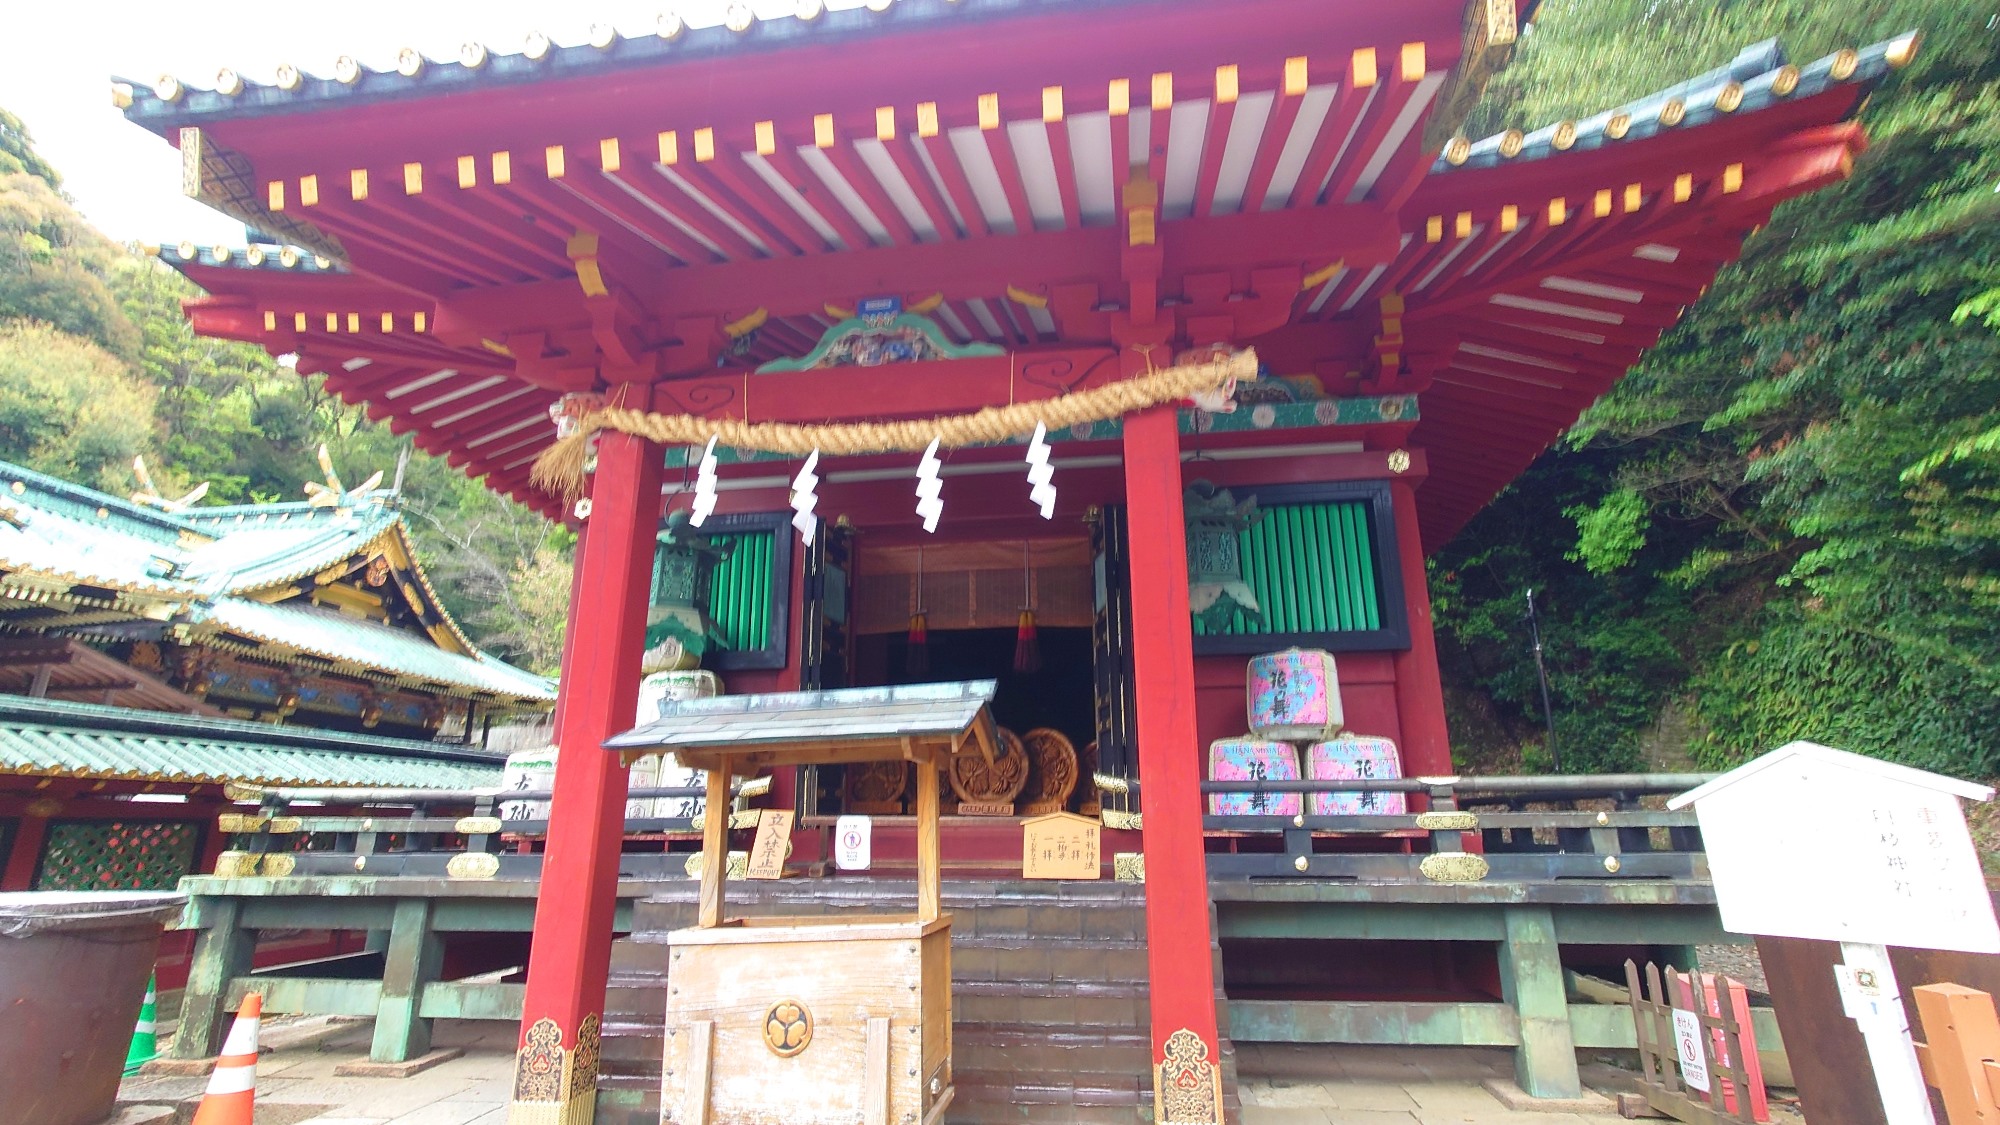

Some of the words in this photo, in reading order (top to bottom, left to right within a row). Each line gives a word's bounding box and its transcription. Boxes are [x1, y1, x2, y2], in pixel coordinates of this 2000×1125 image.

[1268, 670, 1289, 719] 花の舞
[1248, 761, 1269, 813] 花舞
[1354, 759, 1375, 810] 花舞
[757, 813, 784, 868] 立入禁止
[1043, 836, 1053, 861] 一拝
[1071, 835, 1080, 860] 二拝
[1084, 828, 1096, 870] 拝礼作法
[1676, 1016, 1693, 1029] きけん
